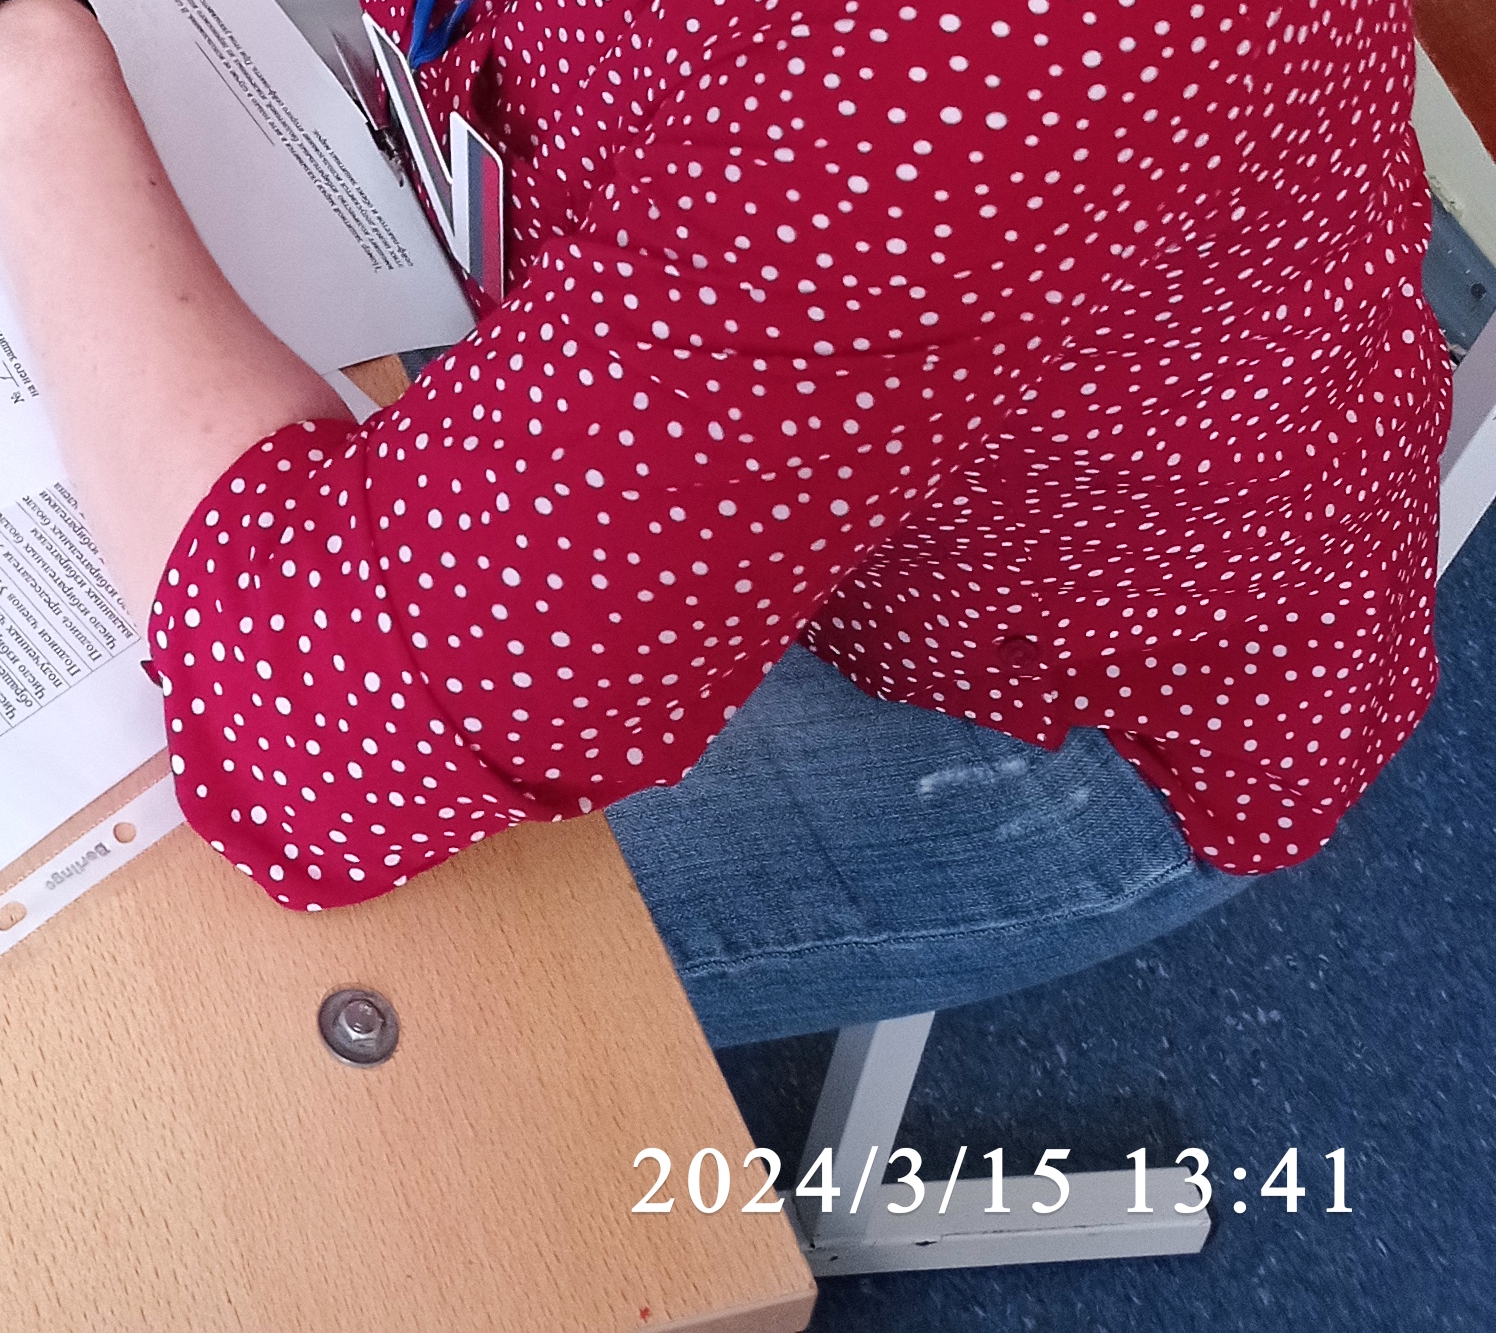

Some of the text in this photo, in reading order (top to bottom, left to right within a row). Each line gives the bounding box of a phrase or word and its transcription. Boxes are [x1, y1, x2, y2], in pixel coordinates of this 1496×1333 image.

[21, 495, 52, 526] бюлле
[2, 550, 63, 616] председателя
[22, 542, 91, 617] избирательных
[6, 593, 38, 630] членов
[88, 616, 117, 651] Число
[5, 624, 64, 689] полученных
[37, 628, 82, 677] Подписи
[61, 615, 103, 663] Подпись
[17, 664, 46, 700] Число
